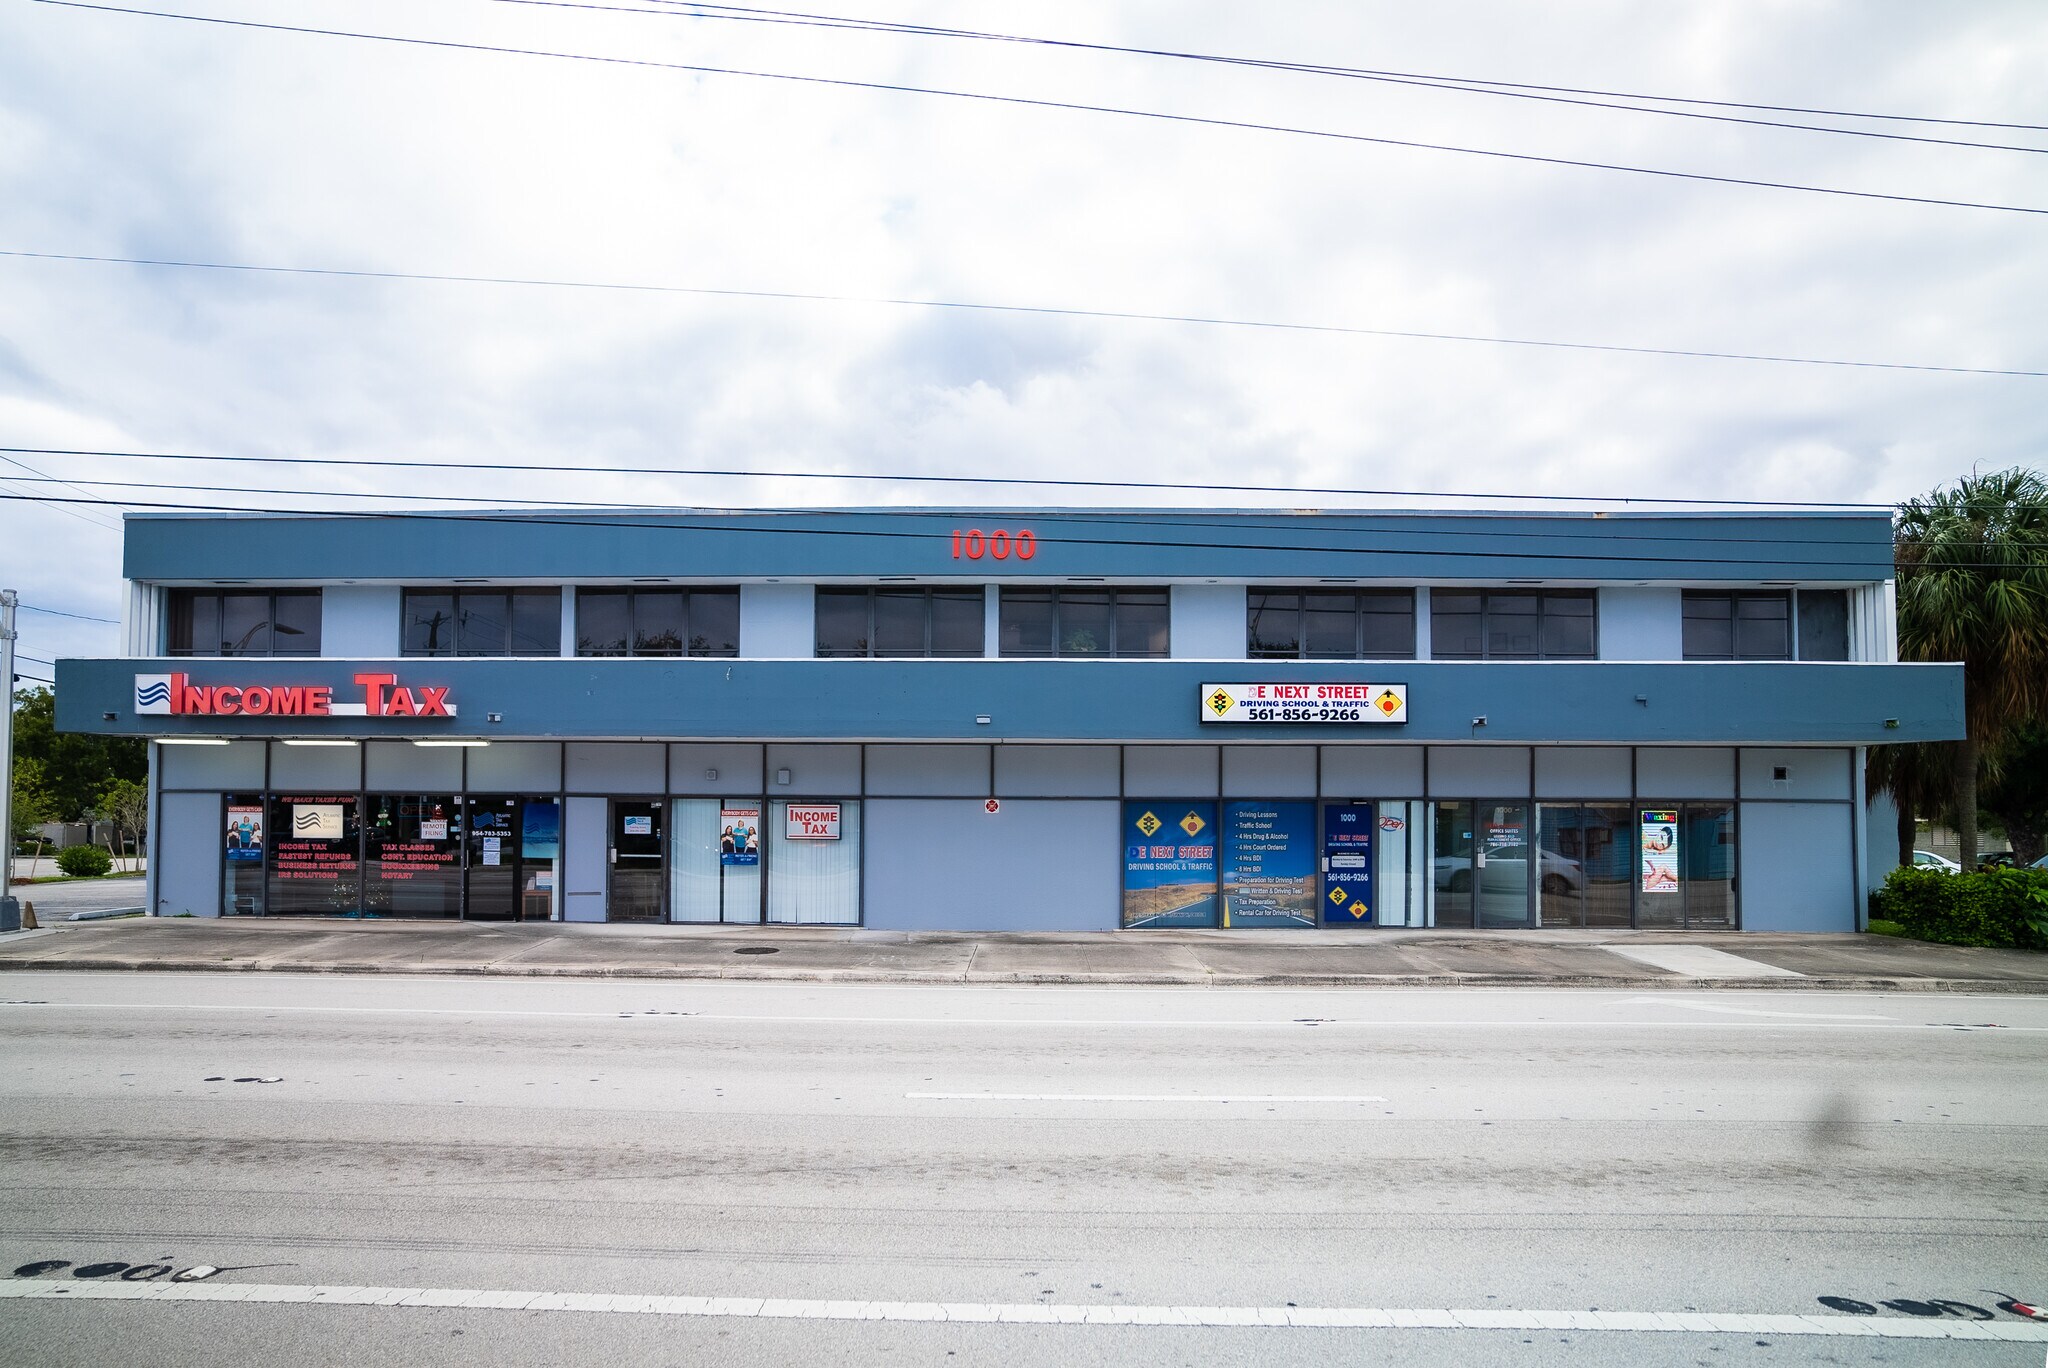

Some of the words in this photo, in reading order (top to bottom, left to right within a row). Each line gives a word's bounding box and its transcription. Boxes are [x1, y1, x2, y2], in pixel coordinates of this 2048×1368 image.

[952, 528, 1036, 560] 1000
[171, 673, 332, 715] INCOME
[354, 673, 449, 716] TAX
[1274, 686, 1310, 699] NEXT
[1317, 686, 1369, 699] STREET
[1281, 700, 1320, 708] SCHOOL
[1321, 700, 1330, 708] &
[1332, 700, 1370, 708] TRAFFIC
[1248, 708, 1360, 721] 561-856-9266
[790, 809, 838, 821] INCOME
[1239, 811, 1257, 819] Driving
[1340, 814, 1356, 822] 1000
[1645, 813, 1675, 822] Waxing
[802, 822, 828, 834] TAX
[1252, 833, 1265, 841] Drug
[381, 843, 398, 851] TAX
[1150, 846, 1175, 858] NEXT
[1178, 846, 1213, 858] STREET
[278, 871, 292, 879] IRS
[293, 871, 338, 879] SOLUTIONS
[1328, 873, 1368, 881] 561-856-9266
[1239, 876, 1267, 885] Preparation
[1275, 876, 1293, 885] Driving
[1274, 887, 1292, 895] Driving
[1248, 898, 1276, 906] Preparation
[1272, 909, 1290, 917] Driving
